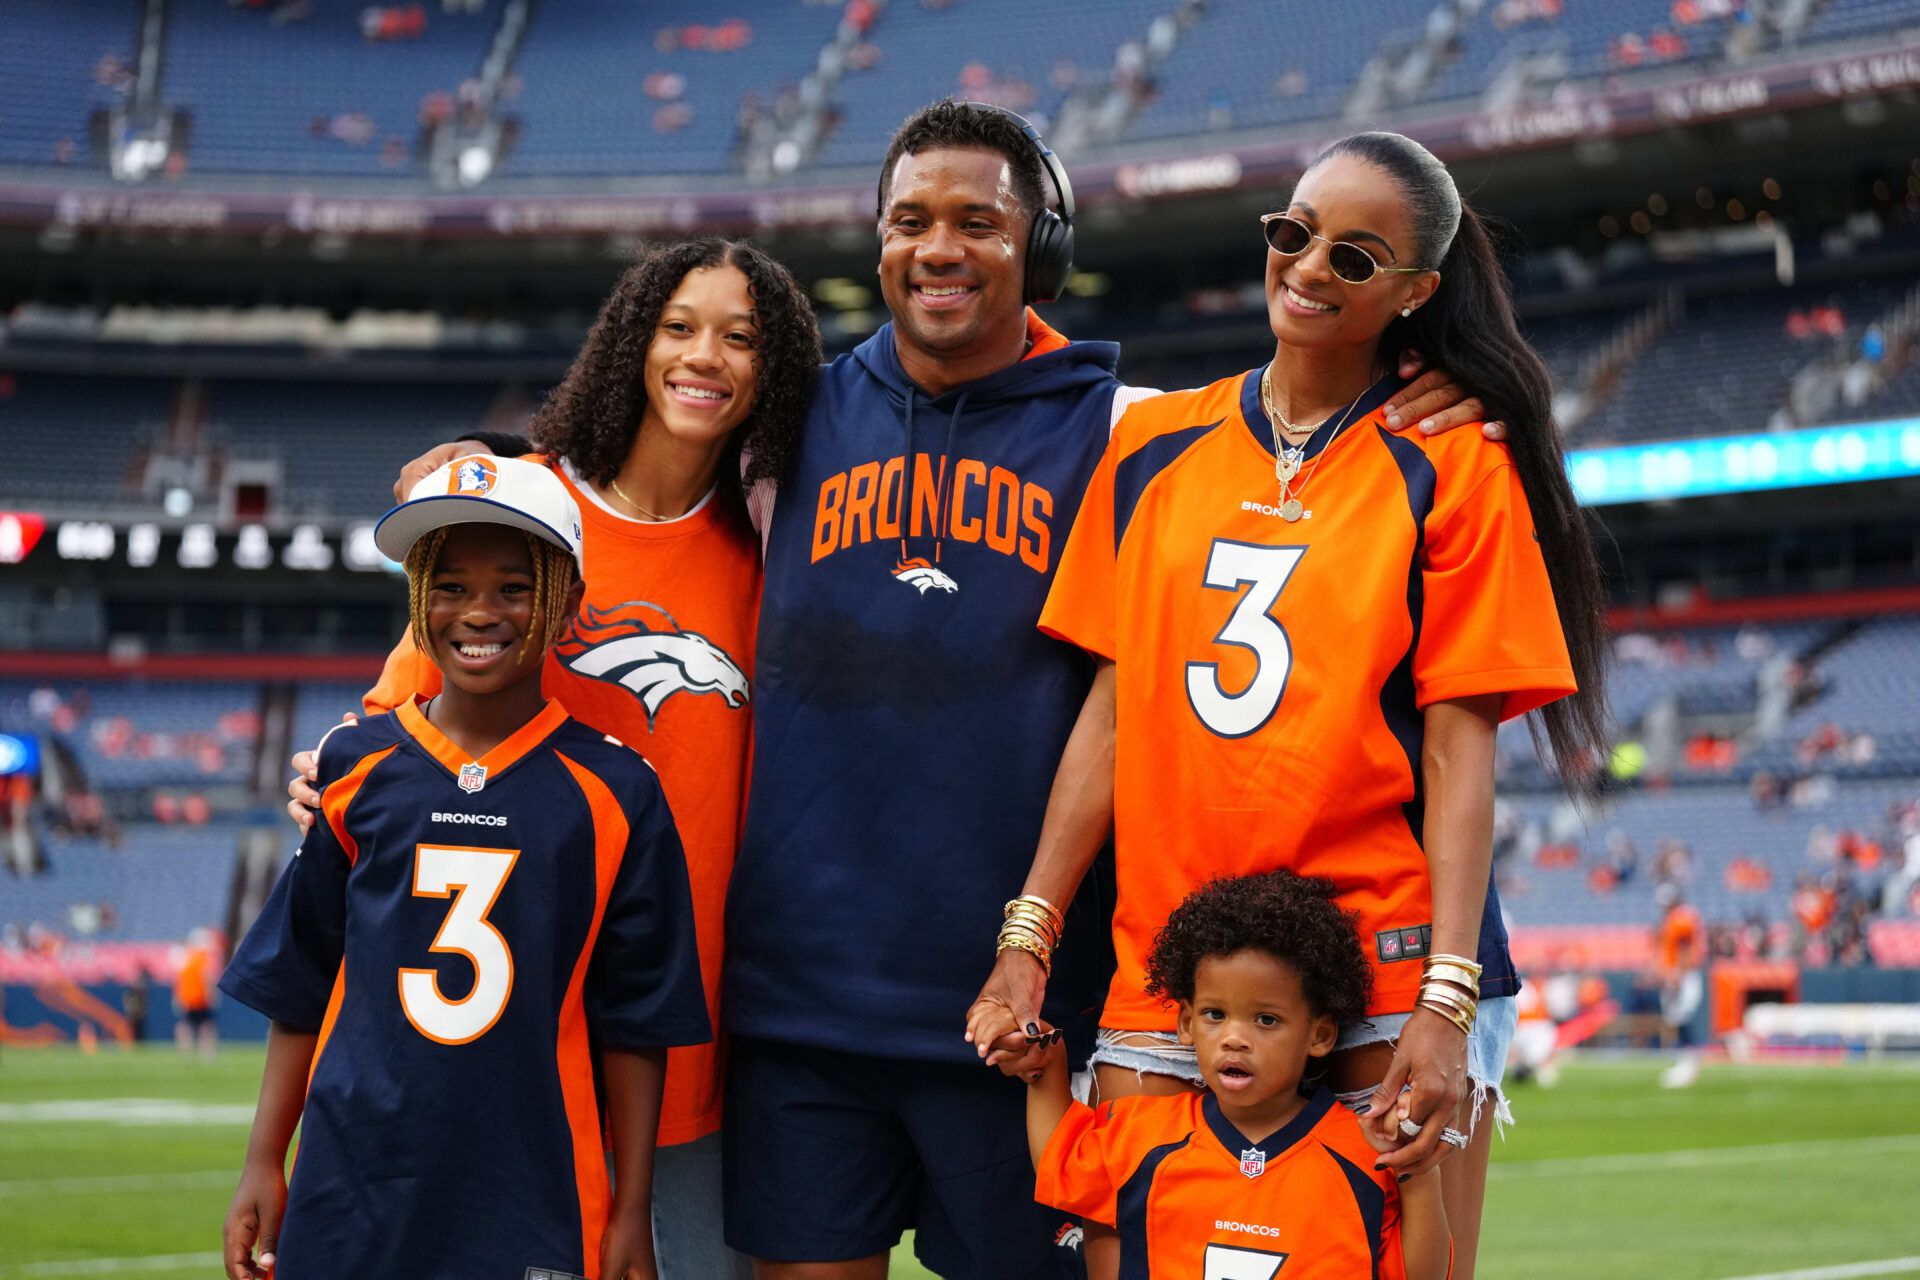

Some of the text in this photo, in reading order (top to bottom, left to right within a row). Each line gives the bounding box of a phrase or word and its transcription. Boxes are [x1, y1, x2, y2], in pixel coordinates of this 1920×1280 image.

[811, 452, 1053, 574] BRONCOS
[1241, 501, 1313, 519] BRONS
[1185, 536, 1311, 740] 3
[461, 774, 480, 788] NFL
[431, 812, 508, 826] BRONCOS
[398, 843, 521, 1045] 3
[1243, 1161, 1261, 1173] NFL
[1215, 1220, 1280, 1237] BRONCOS
